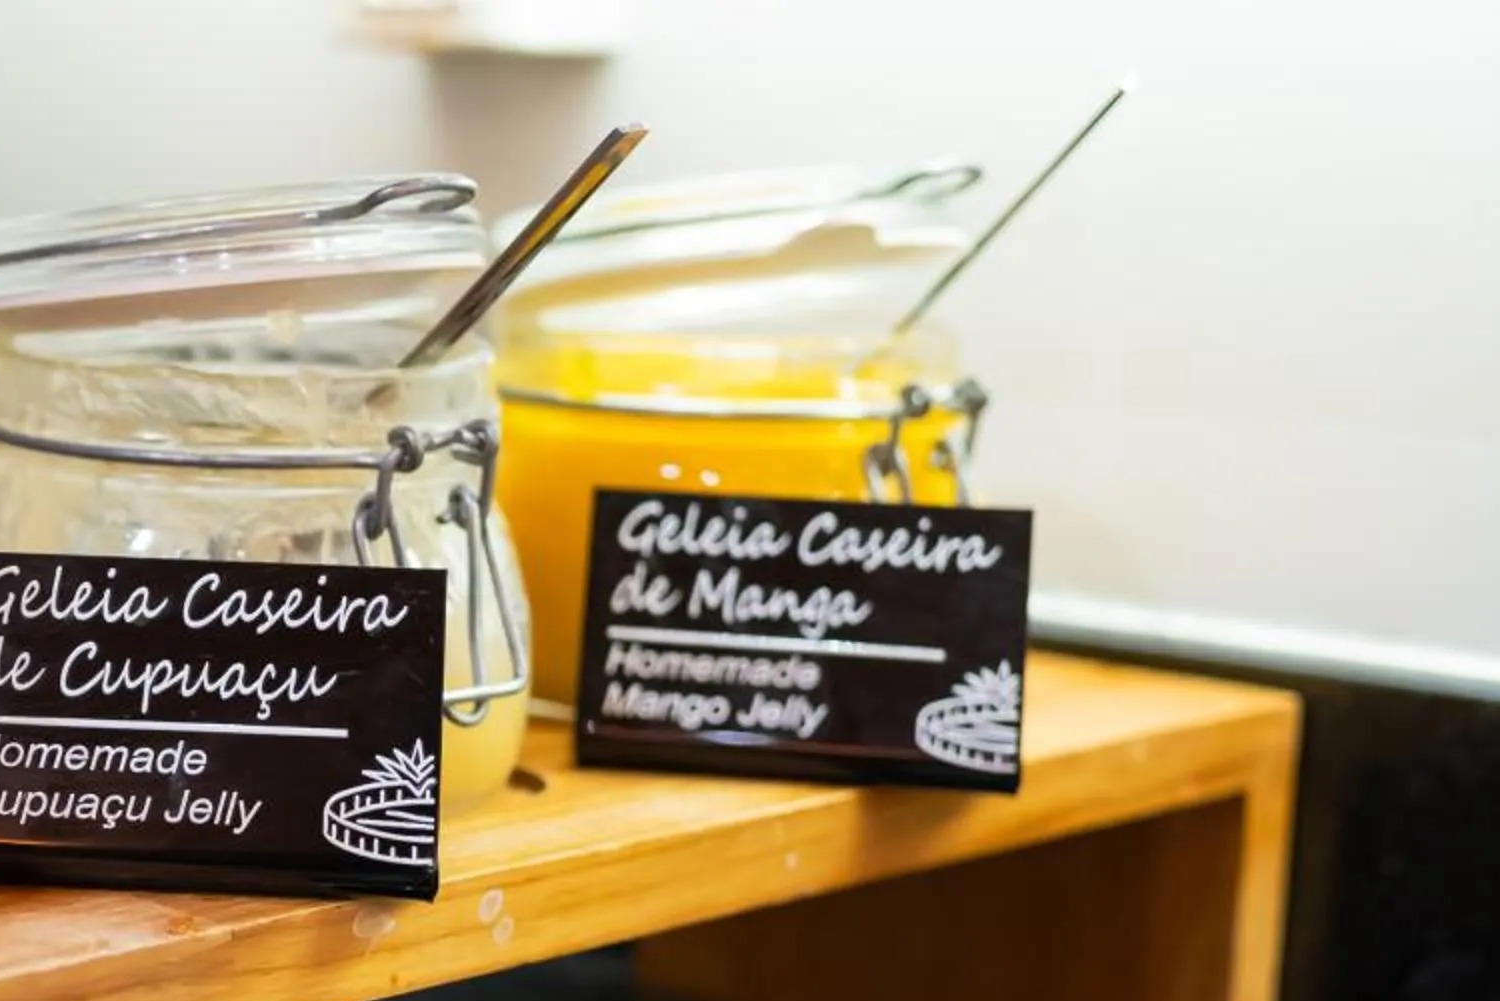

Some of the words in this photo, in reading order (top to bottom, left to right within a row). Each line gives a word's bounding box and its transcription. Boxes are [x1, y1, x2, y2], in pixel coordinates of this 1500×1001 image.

[617, 499, 791, 560] Geleia
[797, 510, 1003, 574] Caseira
[182, 572, 409, 635] Caseira
[609, 560, 683, 617] de
[687, 566, 873, 638] Manga
[58, 640, 339, 720] Cupuaçu
[604, 641, 822, 691] Homemade
[601, 681, 732, 731] Mango
[736, 691, 830, 740] Jelly
[164, 789, 262, 834] Jelly
